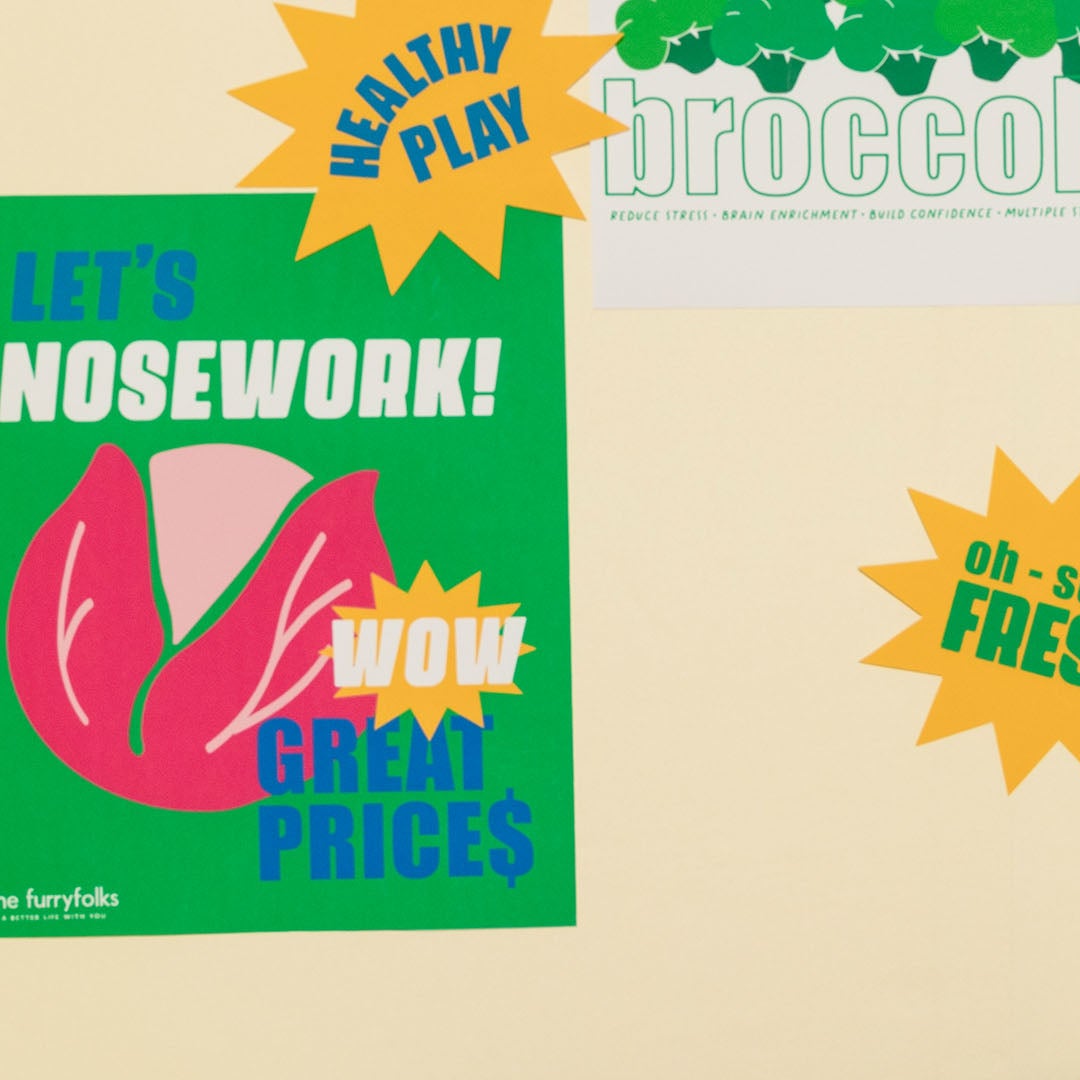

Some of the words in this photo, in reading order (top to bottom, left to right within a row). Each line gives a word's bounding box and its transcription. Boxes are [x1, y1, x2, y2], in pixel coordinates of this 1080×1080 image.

[329, 22, 512, 179] HEALTHY
[398, 86, 531, 183] PLAY
[610, 209, 660, 221] REDUCE
[666, 209, 708, 221] STRESS
[722, 209, 764, 221] BRAIN
[770, 208, 858, 221] ENRICHMENT
[868, 208, 906, 220] BUILD
[910, 207, 992, 219] CONFIDENCE
[1004, 206, 1067, 218] MULTIPLE
[11, 243, 198, 322] LET'S
[0, 337, 502, 423] NOSEWORK!
[965, 539, 1020, 584] oh
[331, 616, 527, 688] WOW
[256, 715, 494, 796] GREAT
[258, 787, 535, 889] PRICE$
[26, 886, 120, 912] furryfolks
